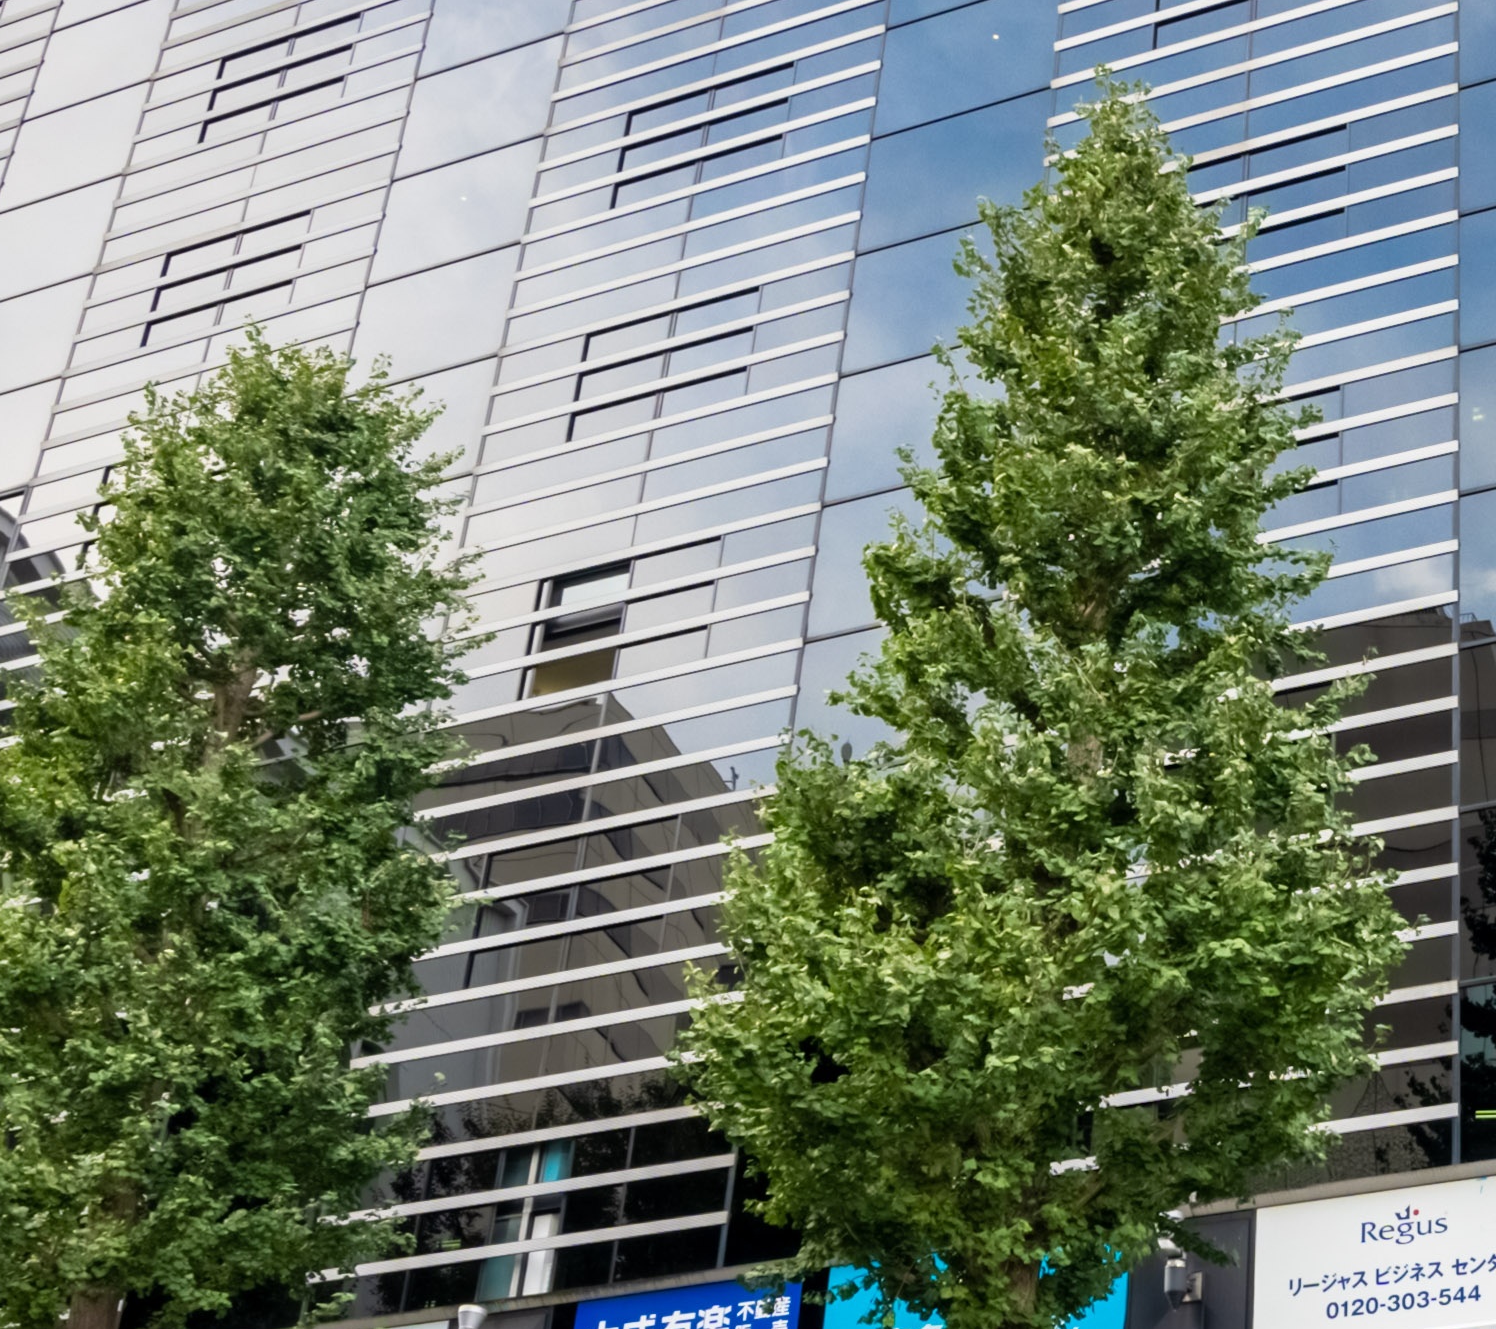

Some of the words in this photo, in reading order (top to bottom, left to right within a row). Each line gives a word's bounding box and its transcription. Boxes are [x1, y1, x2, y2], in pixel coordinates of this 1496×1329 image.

[1360, 1213, 1448, 1245] Regus
[1288, 1268, 1368, 1296] リージャス
[1374, 1259, 1445, 1286] ビジネス
[1326, 1284, 1481, 1320] 0120-303-544
